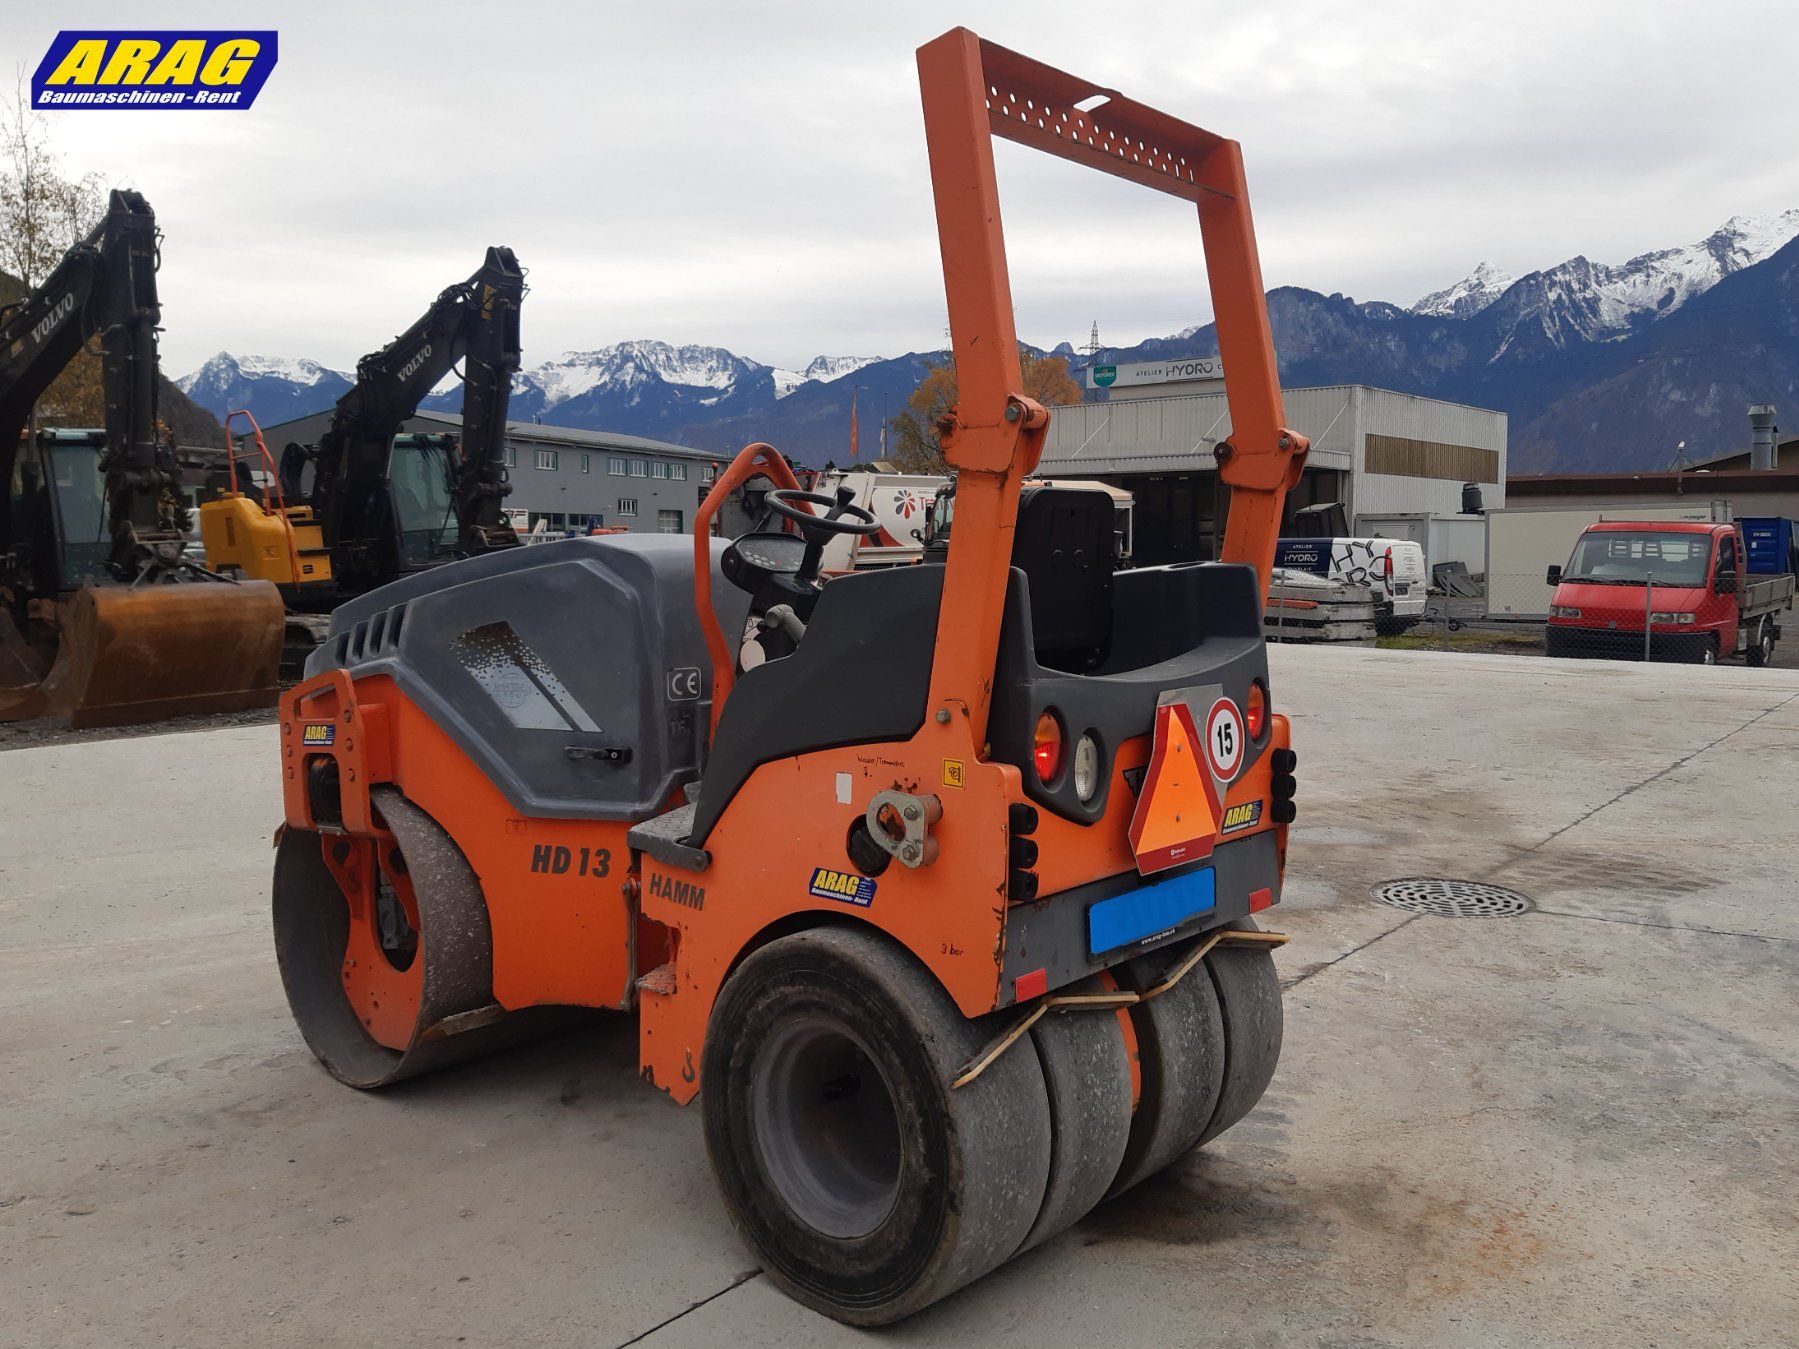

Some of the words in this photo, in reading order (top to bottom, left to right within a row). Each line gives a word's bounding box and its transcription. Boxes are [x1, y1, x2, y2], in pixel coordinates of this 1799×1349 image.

[31, 292, 74, 344] VOLVO
[397, 344, 432, 382] VOLVO
[1135, 369, 1162, 377] ATELIER
[1165, 362, 1214, 377] HYDRO
[1284, 553, 1318, 563] HYDRO
[304, 725, 327, 740] ARAG
[1217, 722, 1233, 758] 15
[1223, 803, 1253, 827] ARAG
[531, 844, 571, 875] HD
[579, 847, 611, 878] 13
[650, 872, 706, 912] HAMM
[813, 869, 860, 896] ARAG
